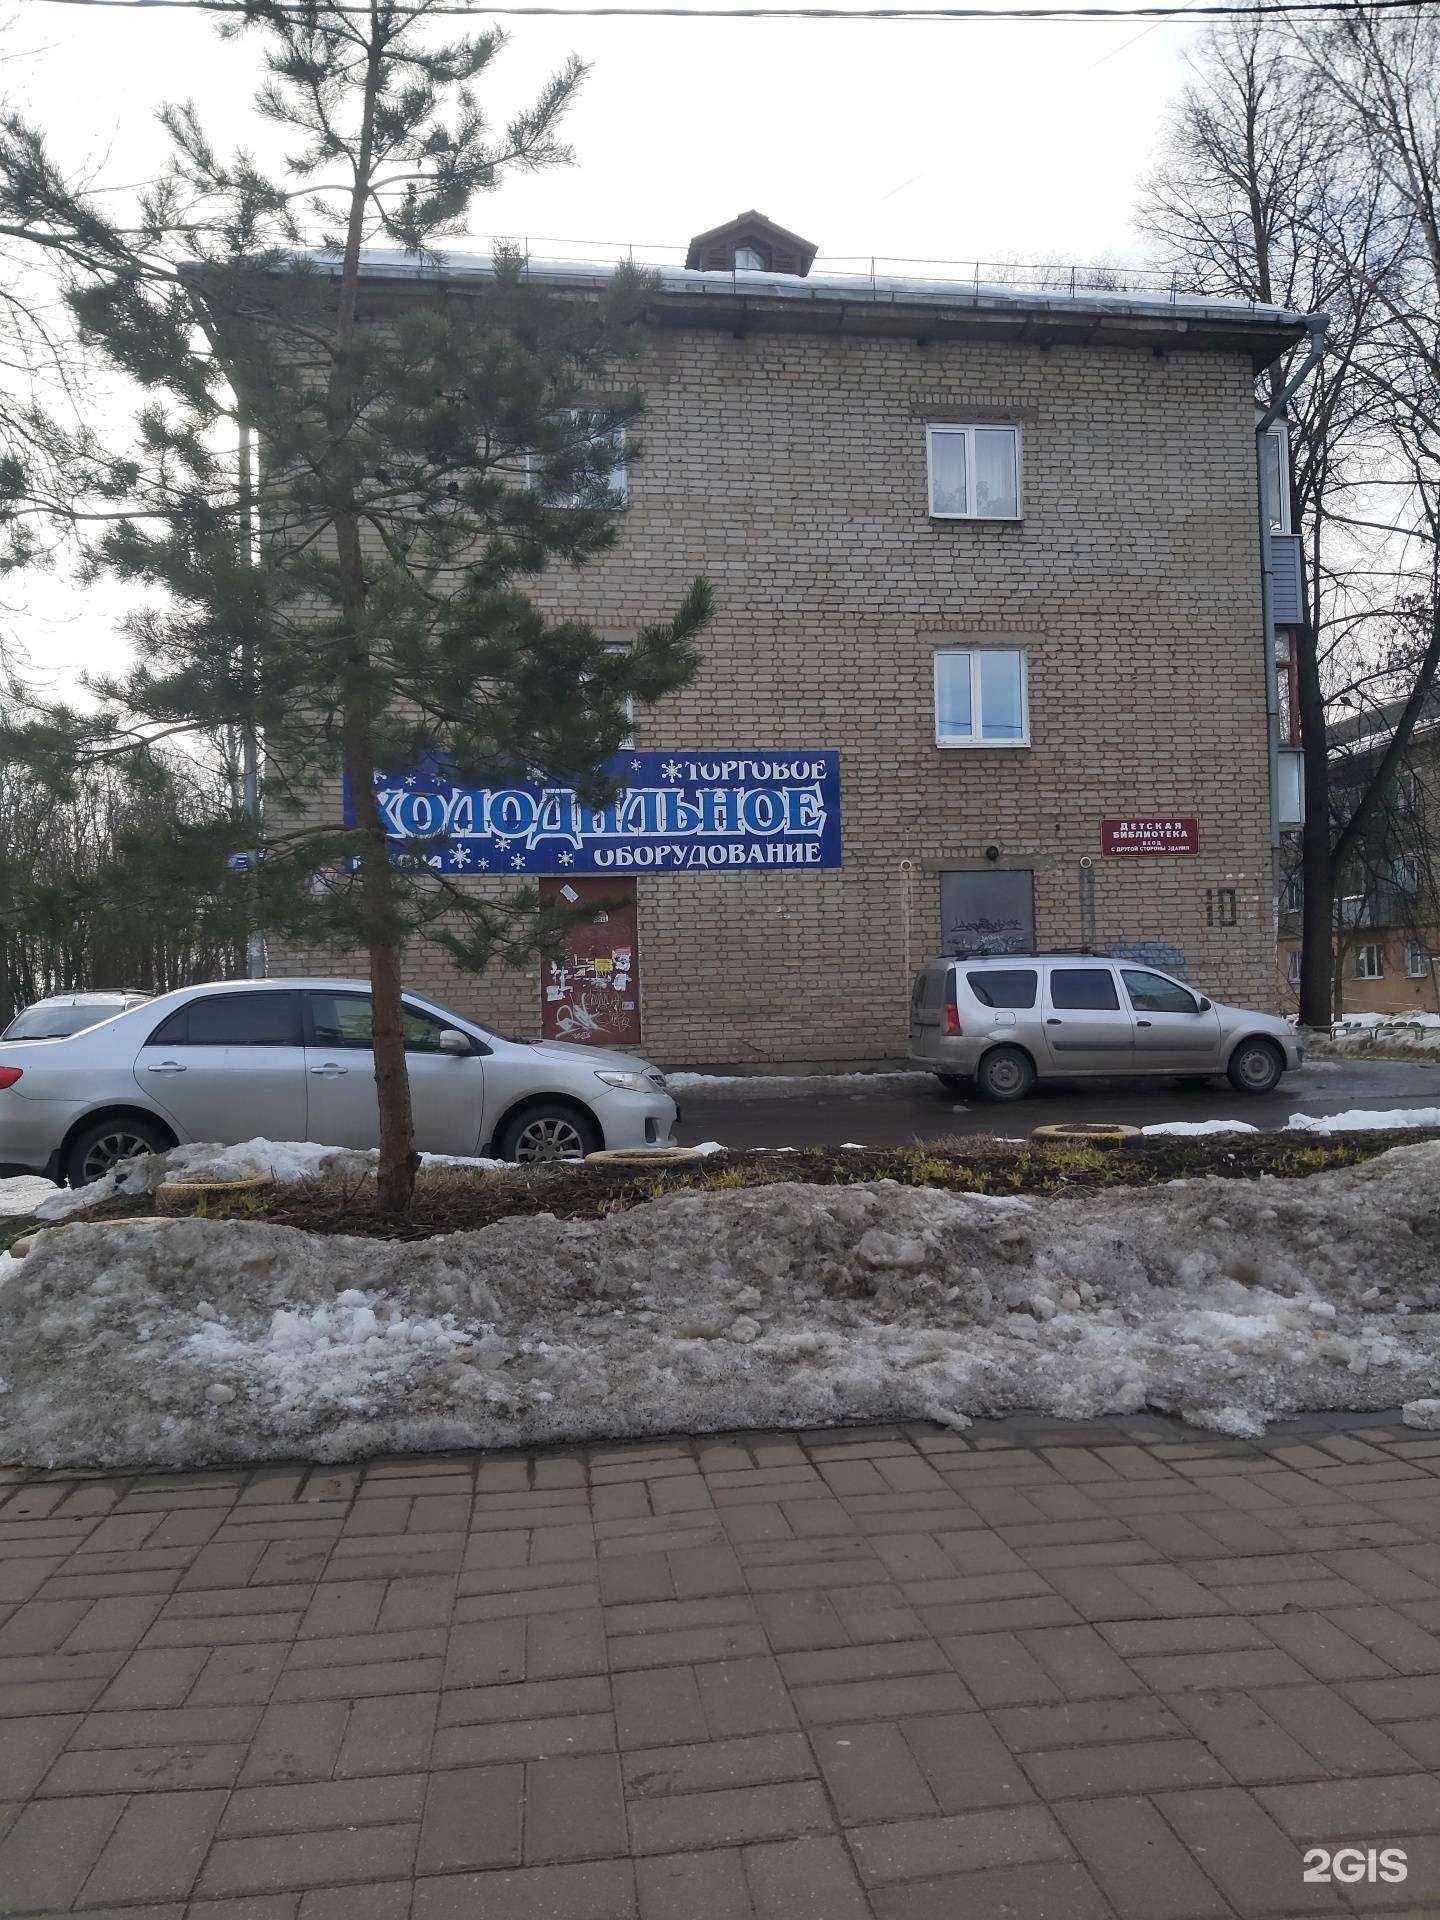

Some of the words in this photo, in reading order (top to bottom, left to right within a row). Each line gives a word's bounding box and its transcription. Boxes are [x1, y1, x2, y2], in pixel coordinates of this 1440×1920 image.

[685, 759, 828, 781] ТОРГОВОЕ
[1120, 822, 1182, 831] ДЕТСКАЯ
[1112, 830, 1188, 839] БИБЛИОТЕКА
[593, 842, 822, 869] ОБОРУДОВАНИЕ
